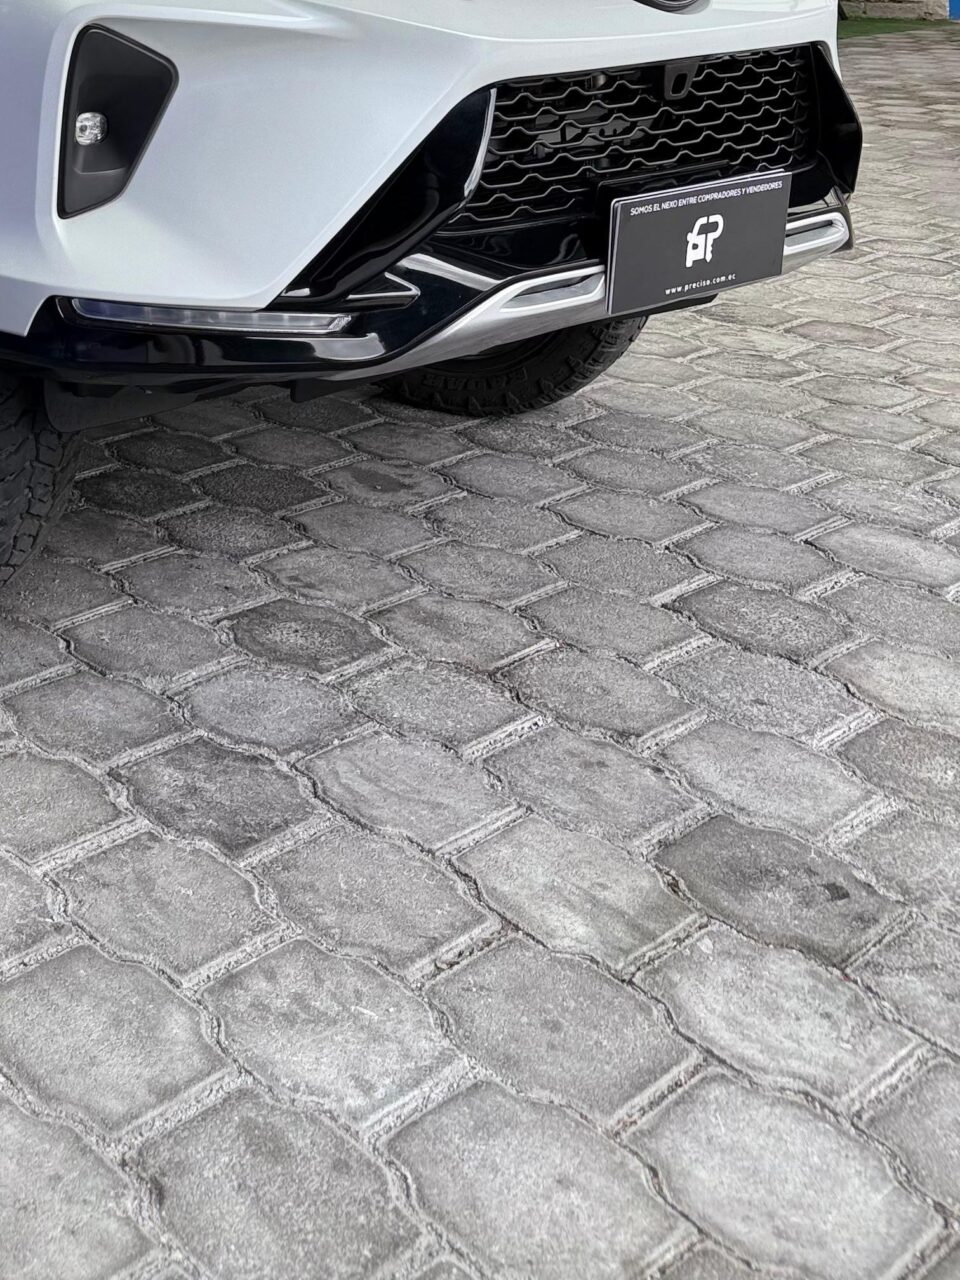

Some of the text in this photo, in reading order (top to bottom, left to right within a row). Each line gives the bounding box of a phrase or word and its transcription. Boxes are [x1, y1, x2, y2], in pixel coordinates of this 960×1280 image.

[630, 180, 783, 216] SOMOS EL NEXO ENTRE COMPRADORES Y VENDEDORES
